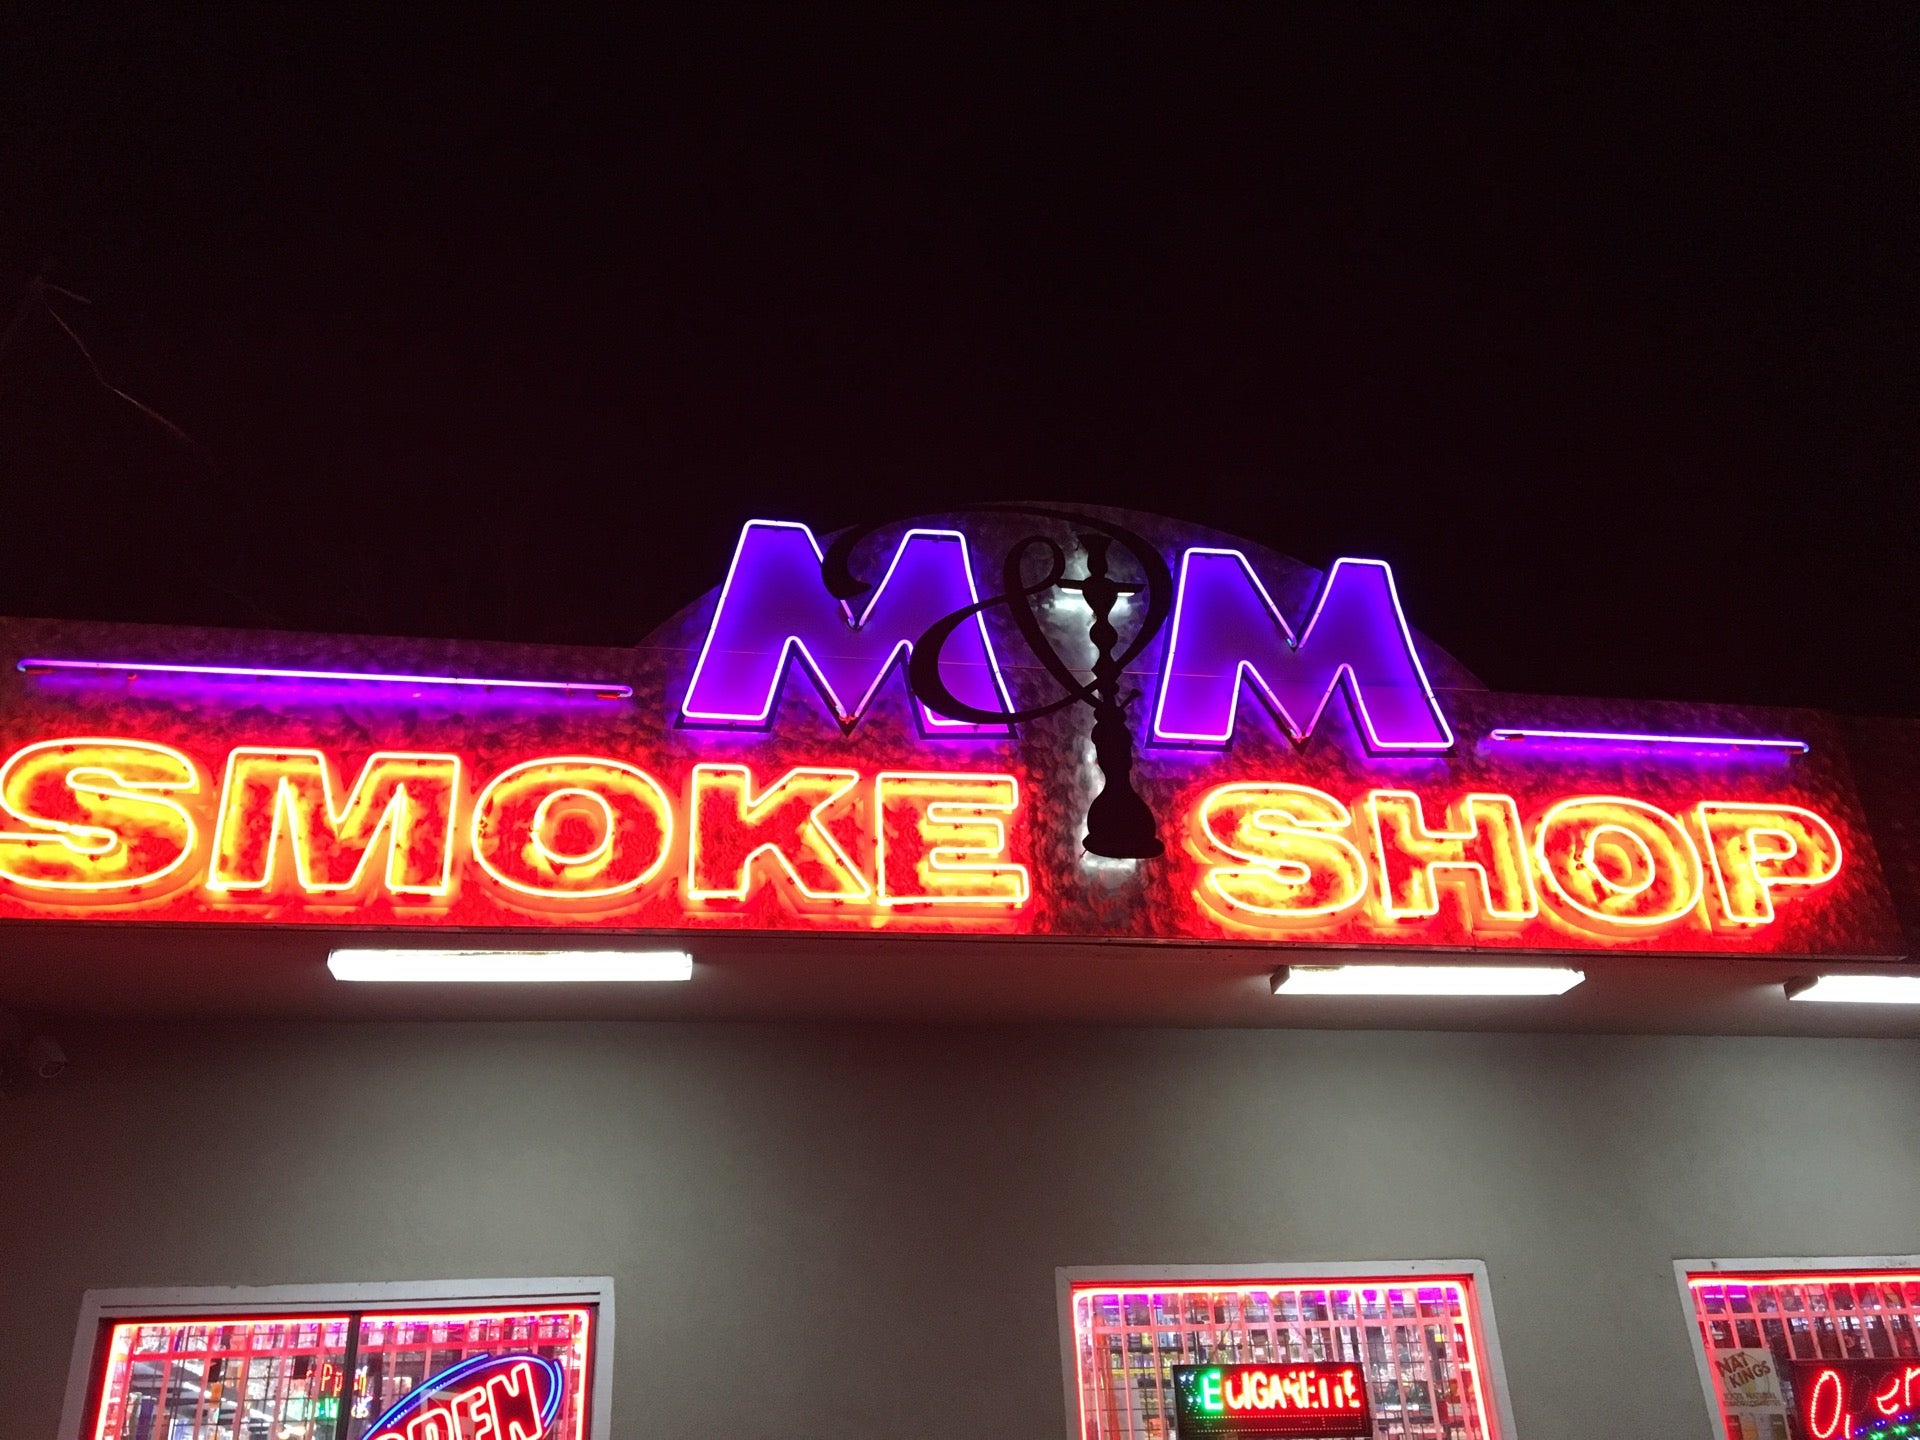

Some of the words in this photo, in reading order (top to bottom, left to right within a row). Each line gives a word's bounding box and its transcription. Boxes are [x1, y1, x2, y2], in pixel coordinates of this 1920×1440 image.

[0, 737, 1030, 909] SMOKE
[1196, 781, 1844, 926] SHOP
[1715, 1352, 1749, 1377] NAT
[1729, 1360, 1771, 1388] KINGS
